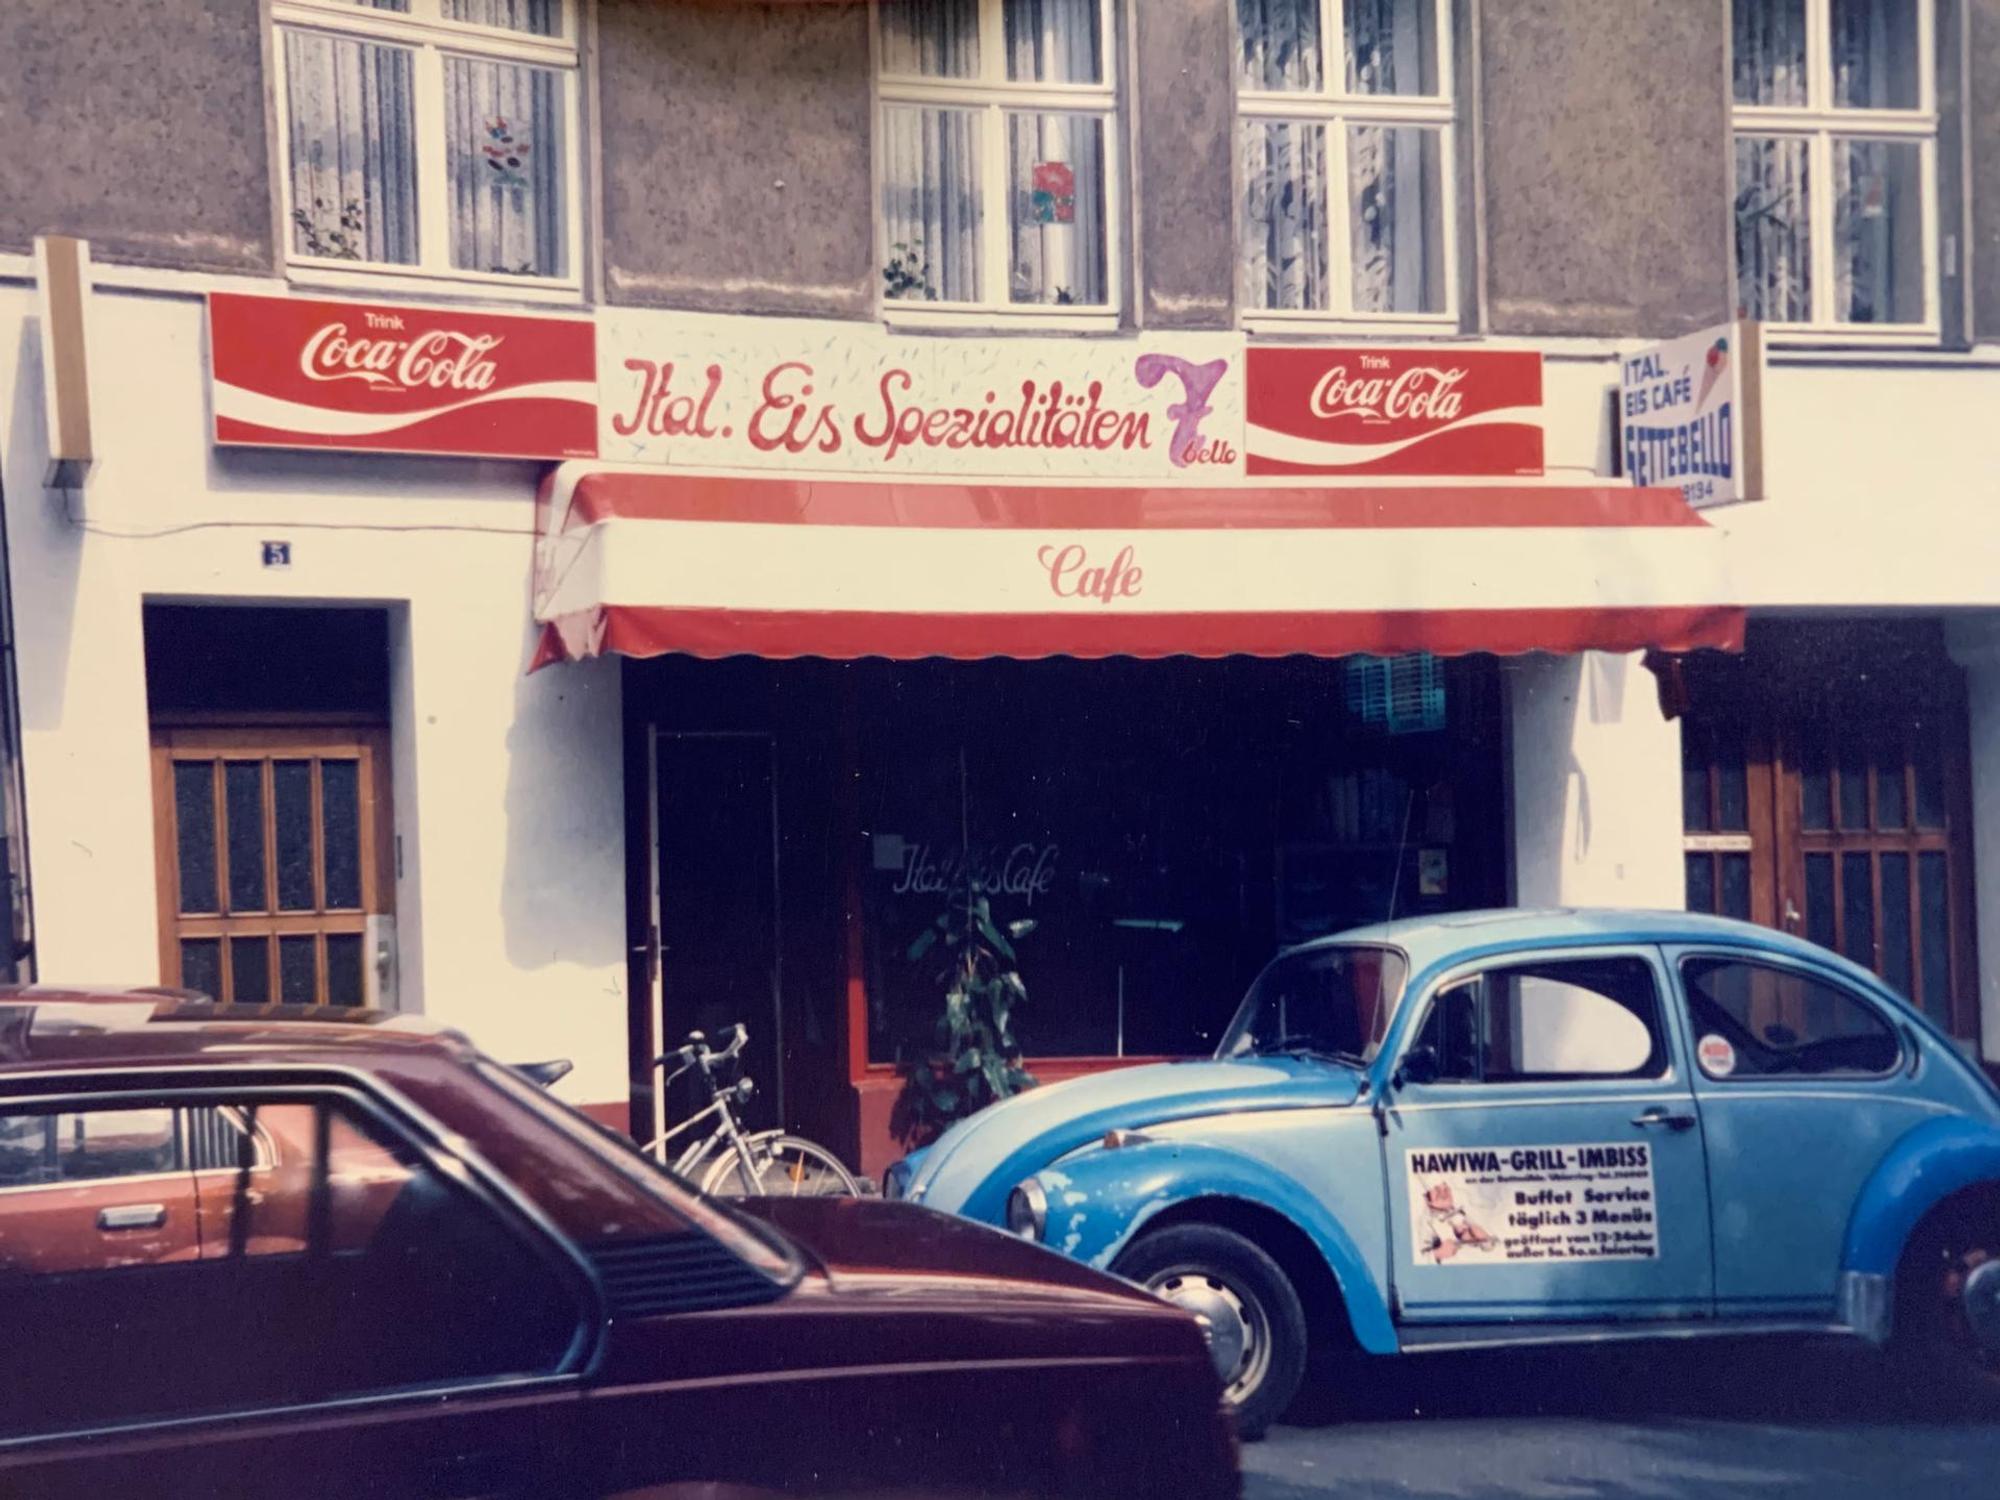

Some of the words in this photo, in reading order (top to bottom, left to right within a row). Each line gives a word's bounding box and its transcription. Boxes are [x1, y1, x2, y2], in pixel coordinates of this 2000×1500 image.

[364, 312, 404, 331] Trink
[300, 323, 505, 390] Coca-Cola
[1359, 355, 1391, 371] Trink
[1625, 353, 1669, 386] ITAL.
[1310, 365, 1469, 421] Coca-Cola
[1626, 389, 1647, 417] EIS
[1653, 365, 1691, 410] CAFÉ
[613, 358, 733, 438] Ital.
[748, 361, 842, 453] Eis
[854, 369, 1153, 461] Spezialitäten
[1135, 353, 1229, 467] 7
[1183, 439, 1237, 465] bello
[1625, 402, 1731, 487] SETTEBELLO
[270, 544, 285, 563] 5
[1038, 544, 1143, 605] Cafe
[1411, 1146, 1648, 1174] HAWIWA-GRILL-IMBISS
[1515, 1190, 1573, 1206] Buffet
[1584, 1187, 1651, 1203] Service
[1508, 1211, 1571, 1230] täglich
[1576, 1211, 1587, 1225] 3
[1592, 1208, 1652, 1224] Menüs
[1567, 1235, 1590, 1243] von
